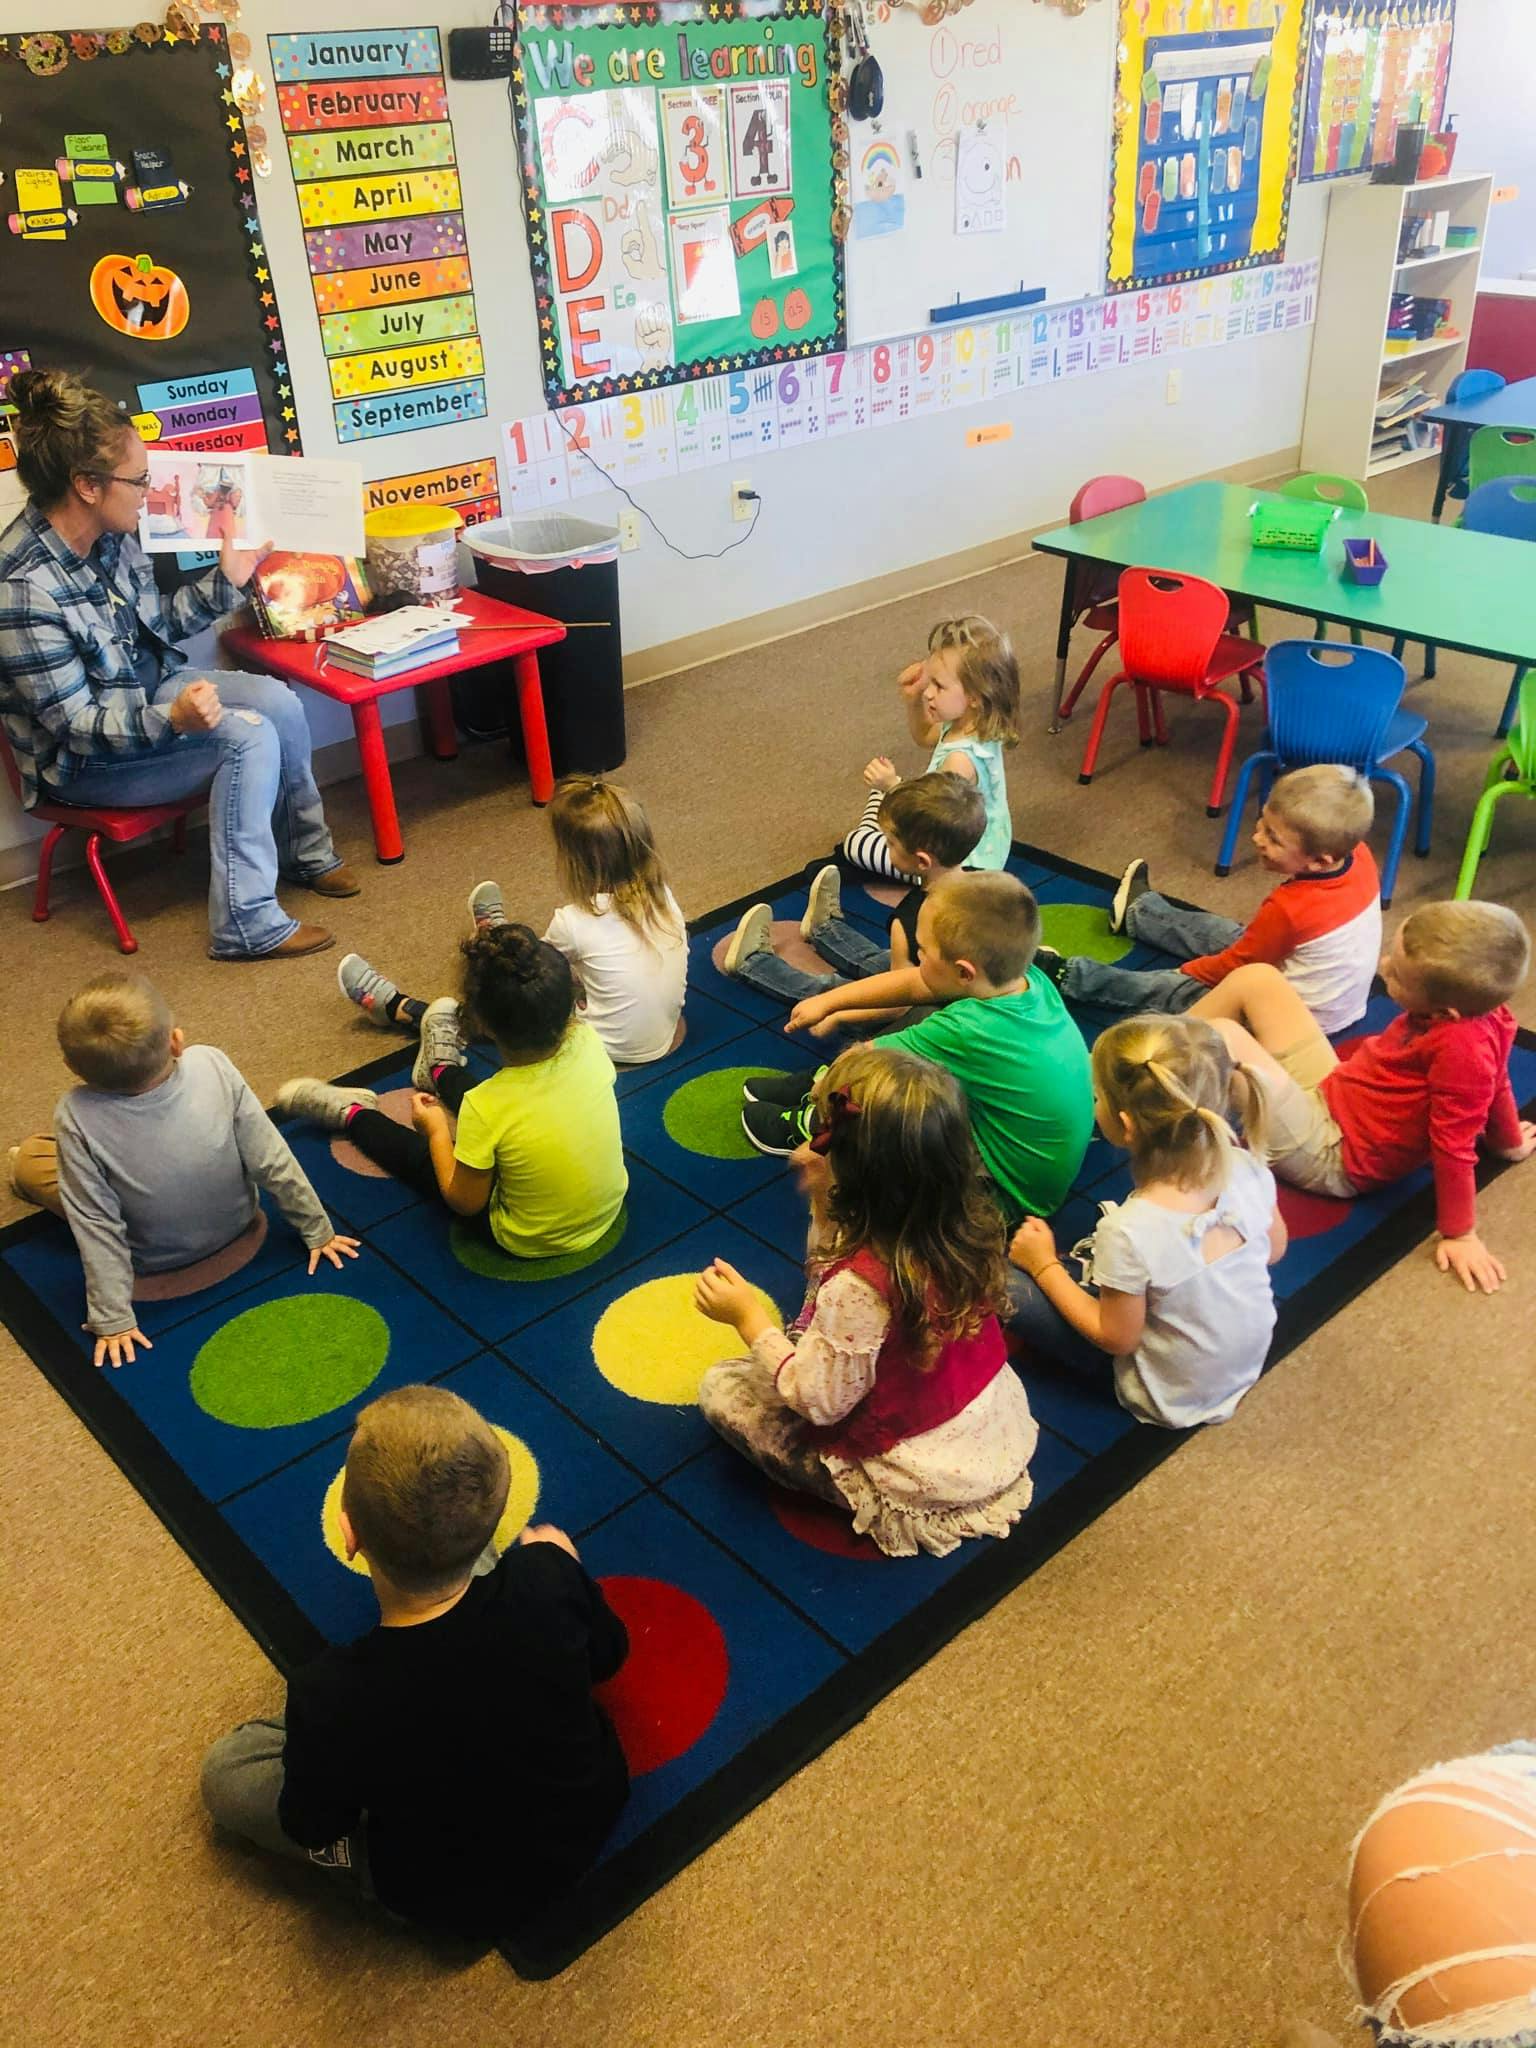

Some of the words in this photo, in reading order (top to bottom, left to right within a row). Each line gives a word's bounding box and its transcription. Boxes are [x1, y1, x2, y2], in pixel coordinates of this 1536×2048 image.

[307, 42, 409, 67] January
[527, 39, 595, 90] We
[607, 47, 666, 83] are
[677, 26, 818, 88] learning
[961, 24, 1002, 68] red
[306, 91, 422, 117] February
[667, 100, 693, 110] Section
[735, 93, 760, 104] Section
[336, 134, 415, 163] March
[742, 109, 774, 175] 4
[354, 182, 413, 211] April
[604, 197, 630, 223] Dd
[365, 232, 413, 254] May
[551, 207, 603, 294] D
[370, 271, 421, 294] June
[612, 284, 637, 310] Ee
[380, 312, 424, 335] July
[566, 295, 611, 380] E
[370, 350, 448, 380] August
[510, 421, 527, 465] 1
[563, 407, 590, 452] 2
[622, 395, 645, 440] 3
[676, 383, 699, 426] 4
[728, 372, 750, 415] 5
[778, 362, 800, 404] 6
[826, 354, 846, 394] 7
[873, 345, 891, 384] 8
[917, 335, 934, 375] 9
[956, 327, 975, 363] 10
[996, 322, 1011, 354] 11
[1033, 313, 1048, 345] 12
[1069, 307, 1084, 338] 13
[1102, 300, 1118, 330] 14
[1136, 293, 1151, 323] 15
[1167, 287, 1182, 315] 16
[167, 380, 229, 401] Sunday
[171, 406, 238, 429] Monday
[351, 393, 473, 429] September
[175, 433, 244, 452] Tuesday
[369, 472, 482, 508] November
